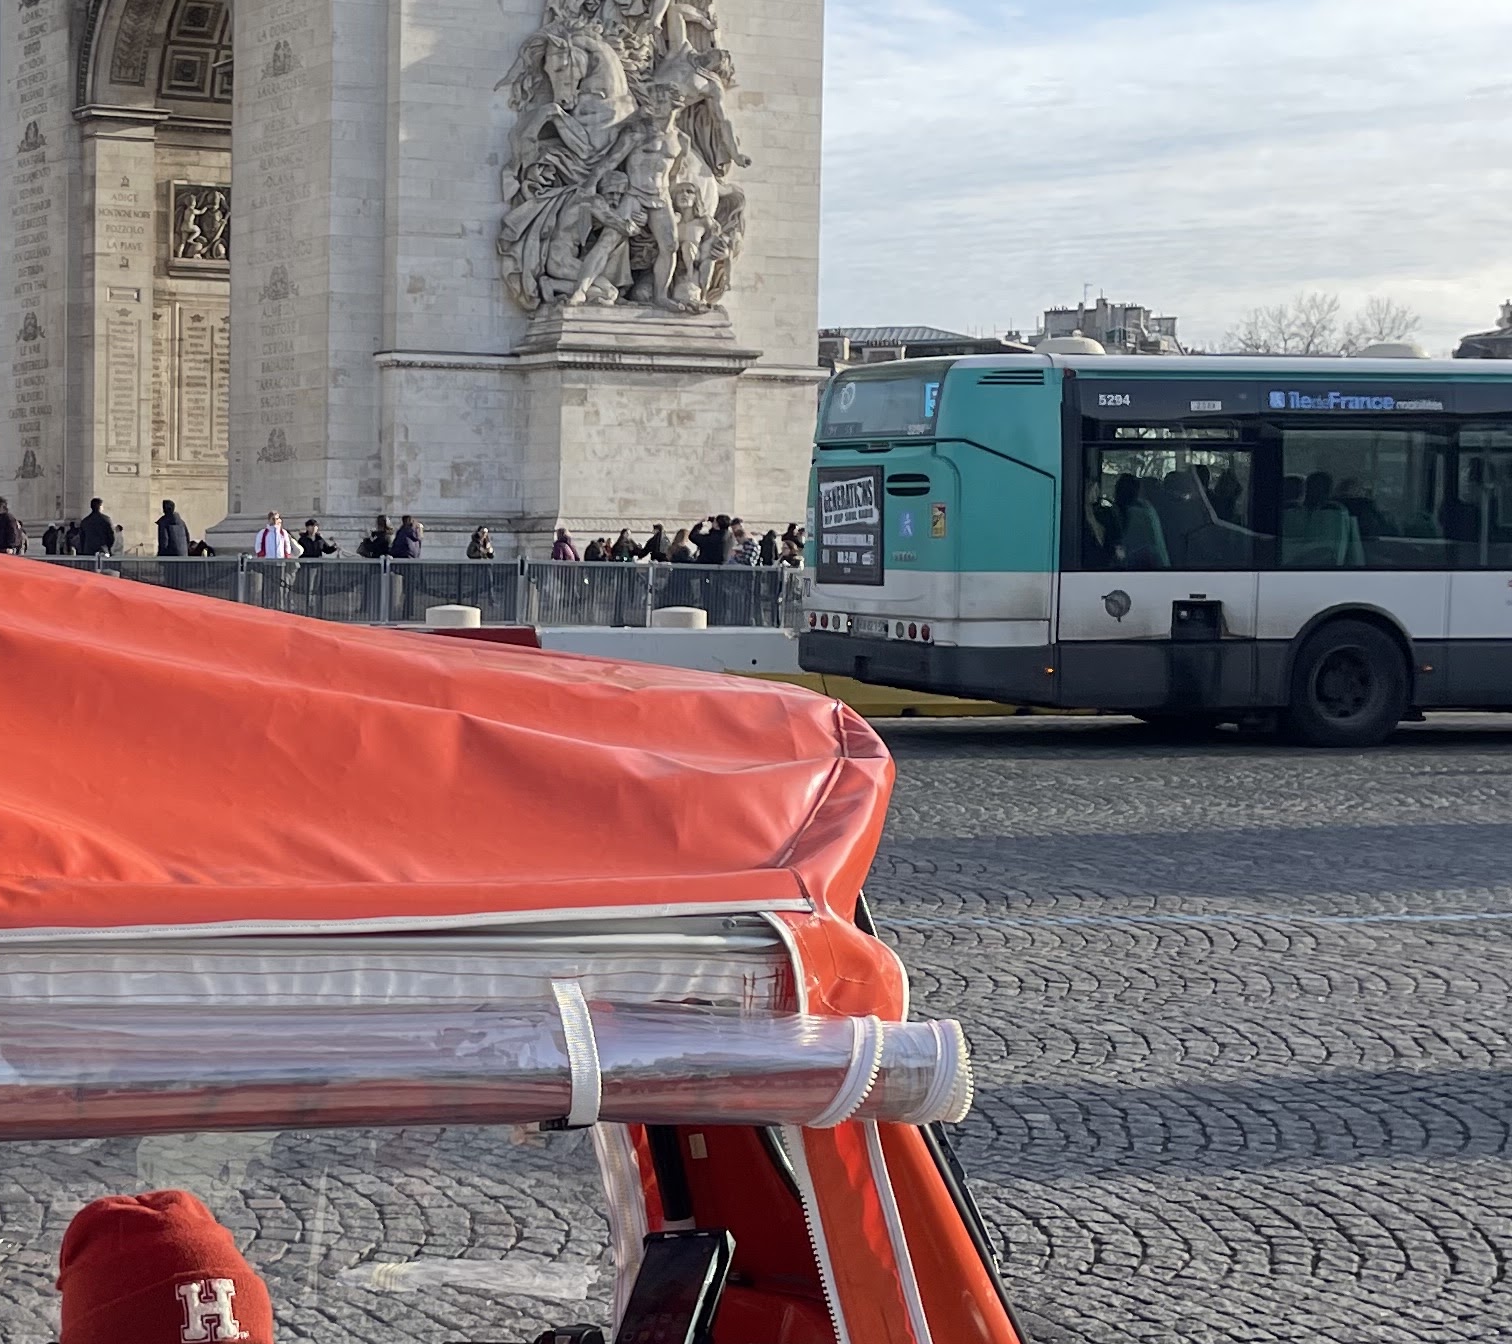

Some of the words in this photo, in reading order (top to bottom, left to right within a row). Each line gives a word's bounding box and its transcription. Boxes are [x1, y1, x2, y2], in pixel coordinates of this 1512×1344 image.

[111, 193, 139, 203] ADIGE
[1098, 394, 1131, 406] 5294
[175, 1278, 240, 1344] H
